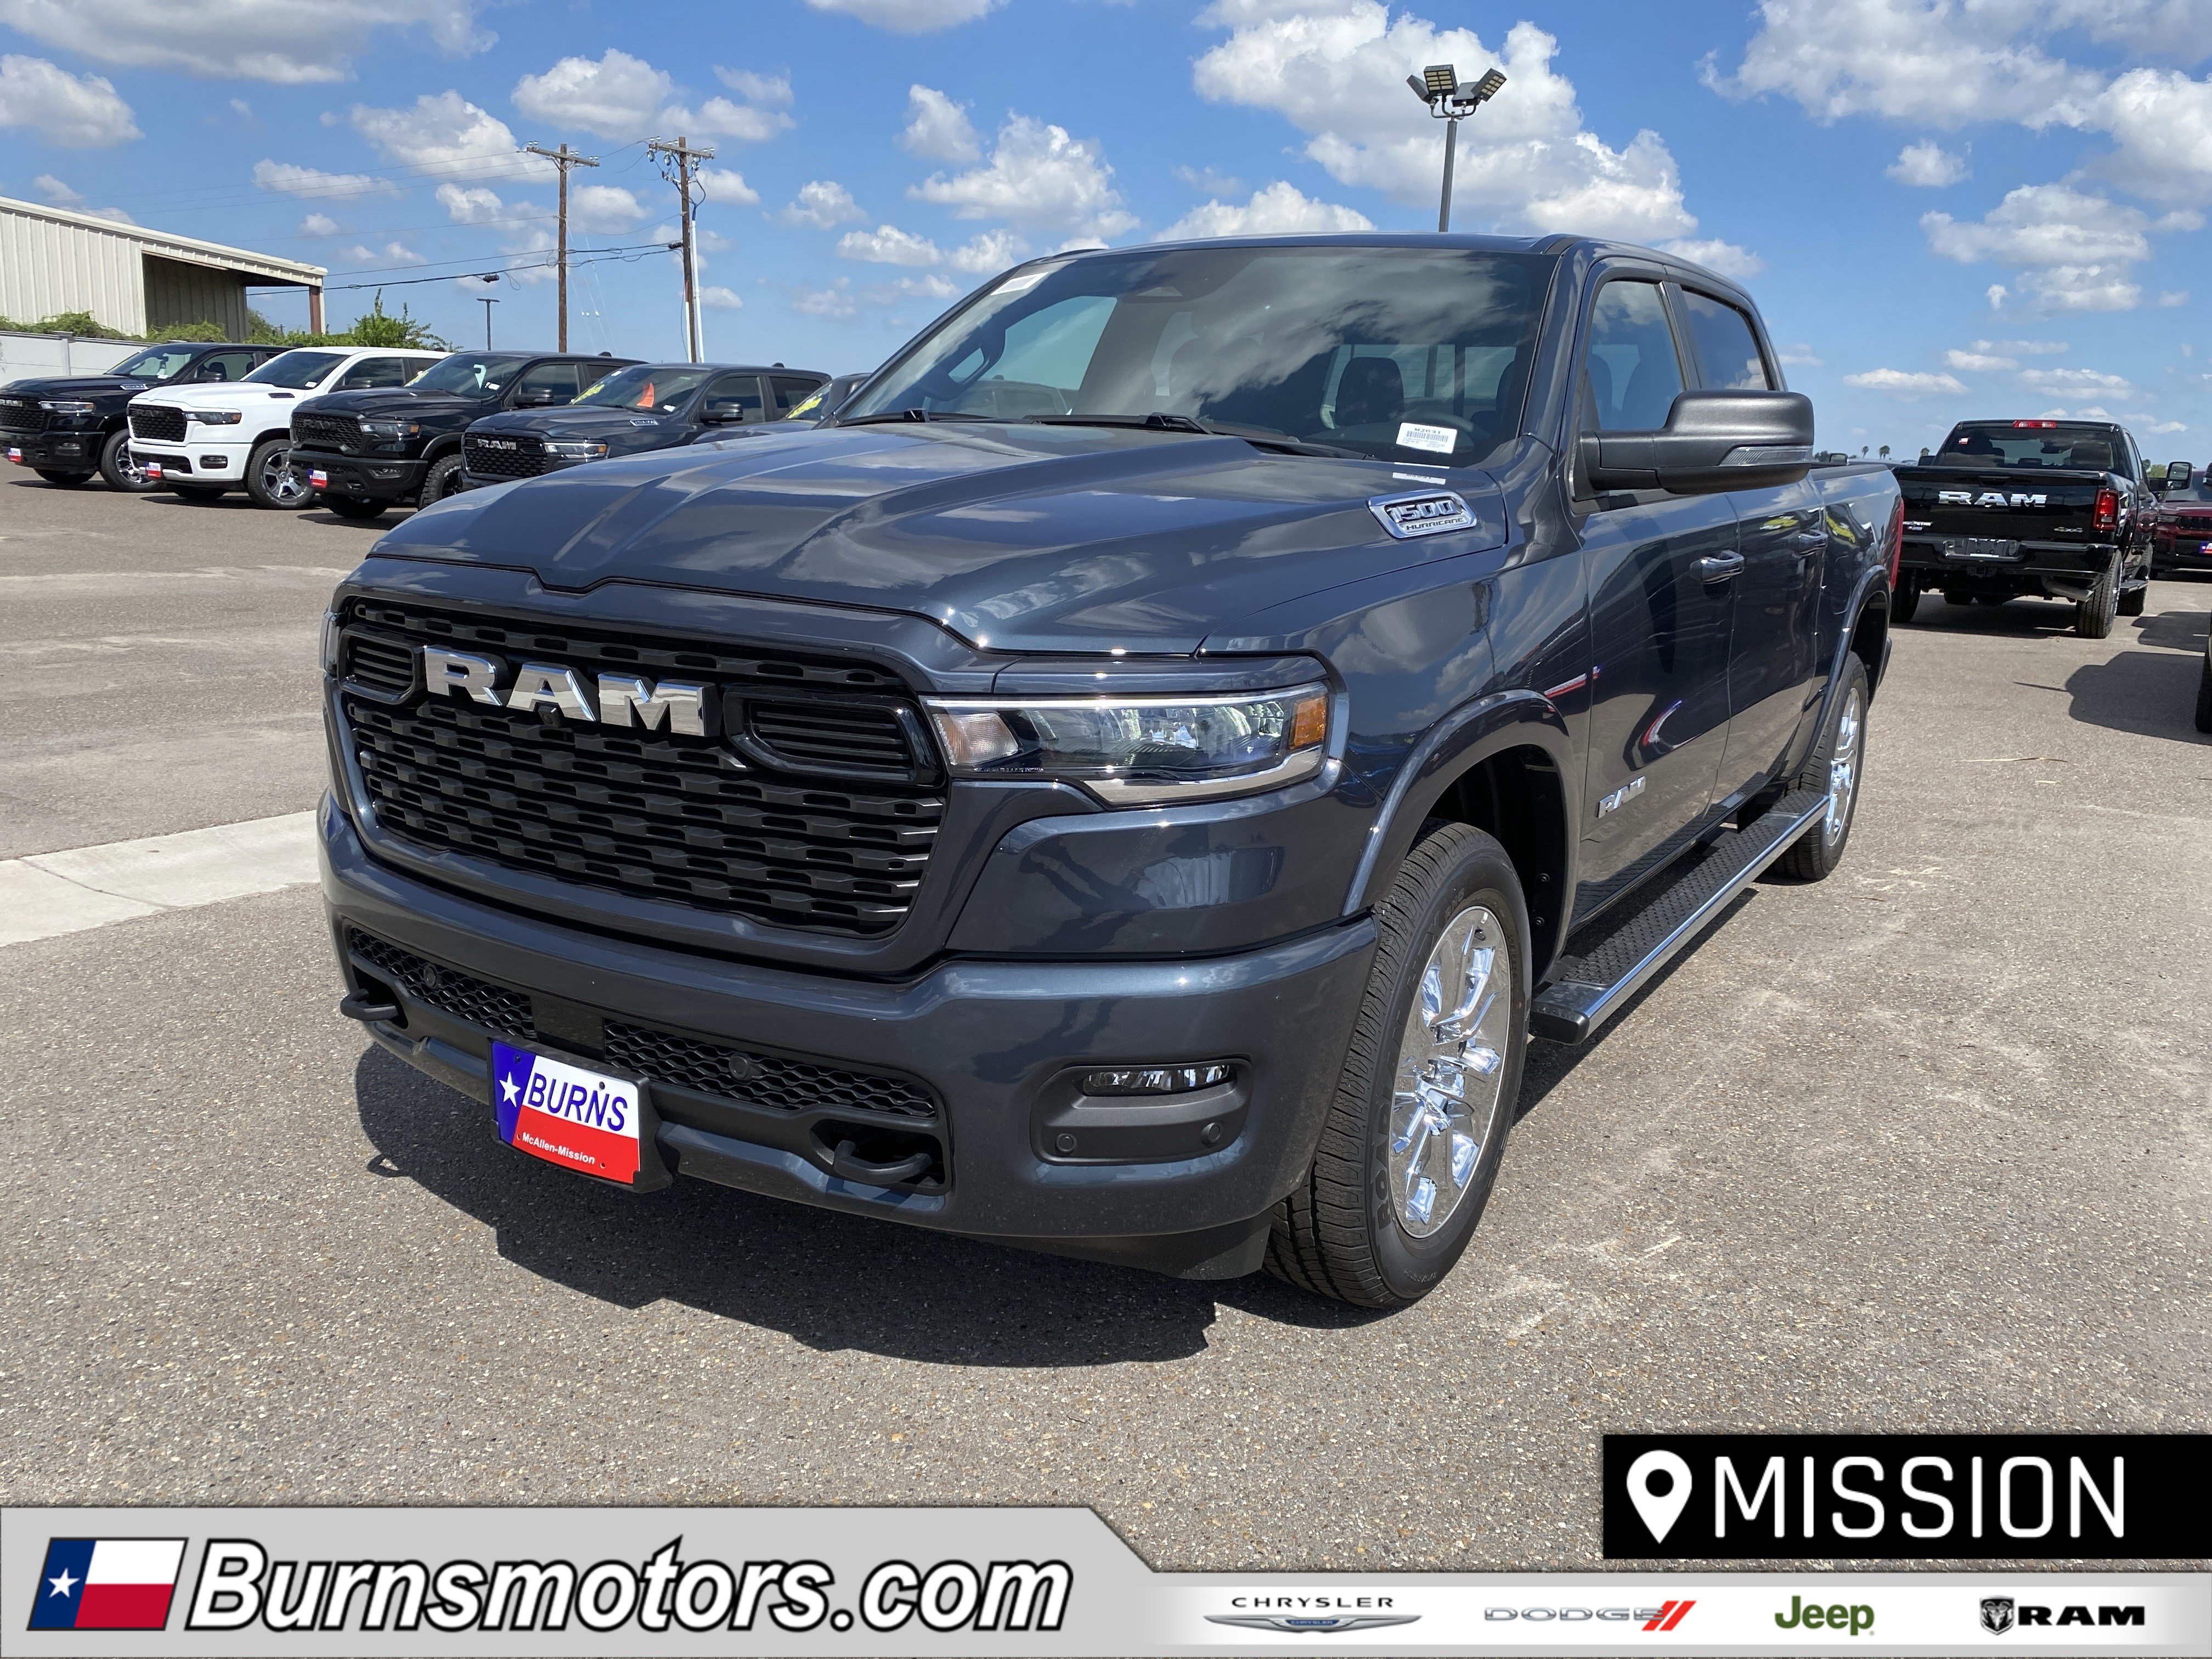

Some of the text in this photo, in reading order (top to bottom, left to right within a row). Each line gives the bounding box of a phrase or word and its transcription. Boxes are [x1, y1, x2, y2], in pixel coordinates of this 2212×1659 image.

[477, 439, 516, 450] RAM
[1387, 499, 1458, 523] 1500
[1938, 490, 2047, 507] RAM
[1406, 517, 1464, 531] HURRICANE
[424, 644, 721, 738] RAM
[1595, 775, 1646, 819] RAM
[527, 1072, 628, 1132] BURNS
[522, 1131, 596, 1165] McAllen-Mission
